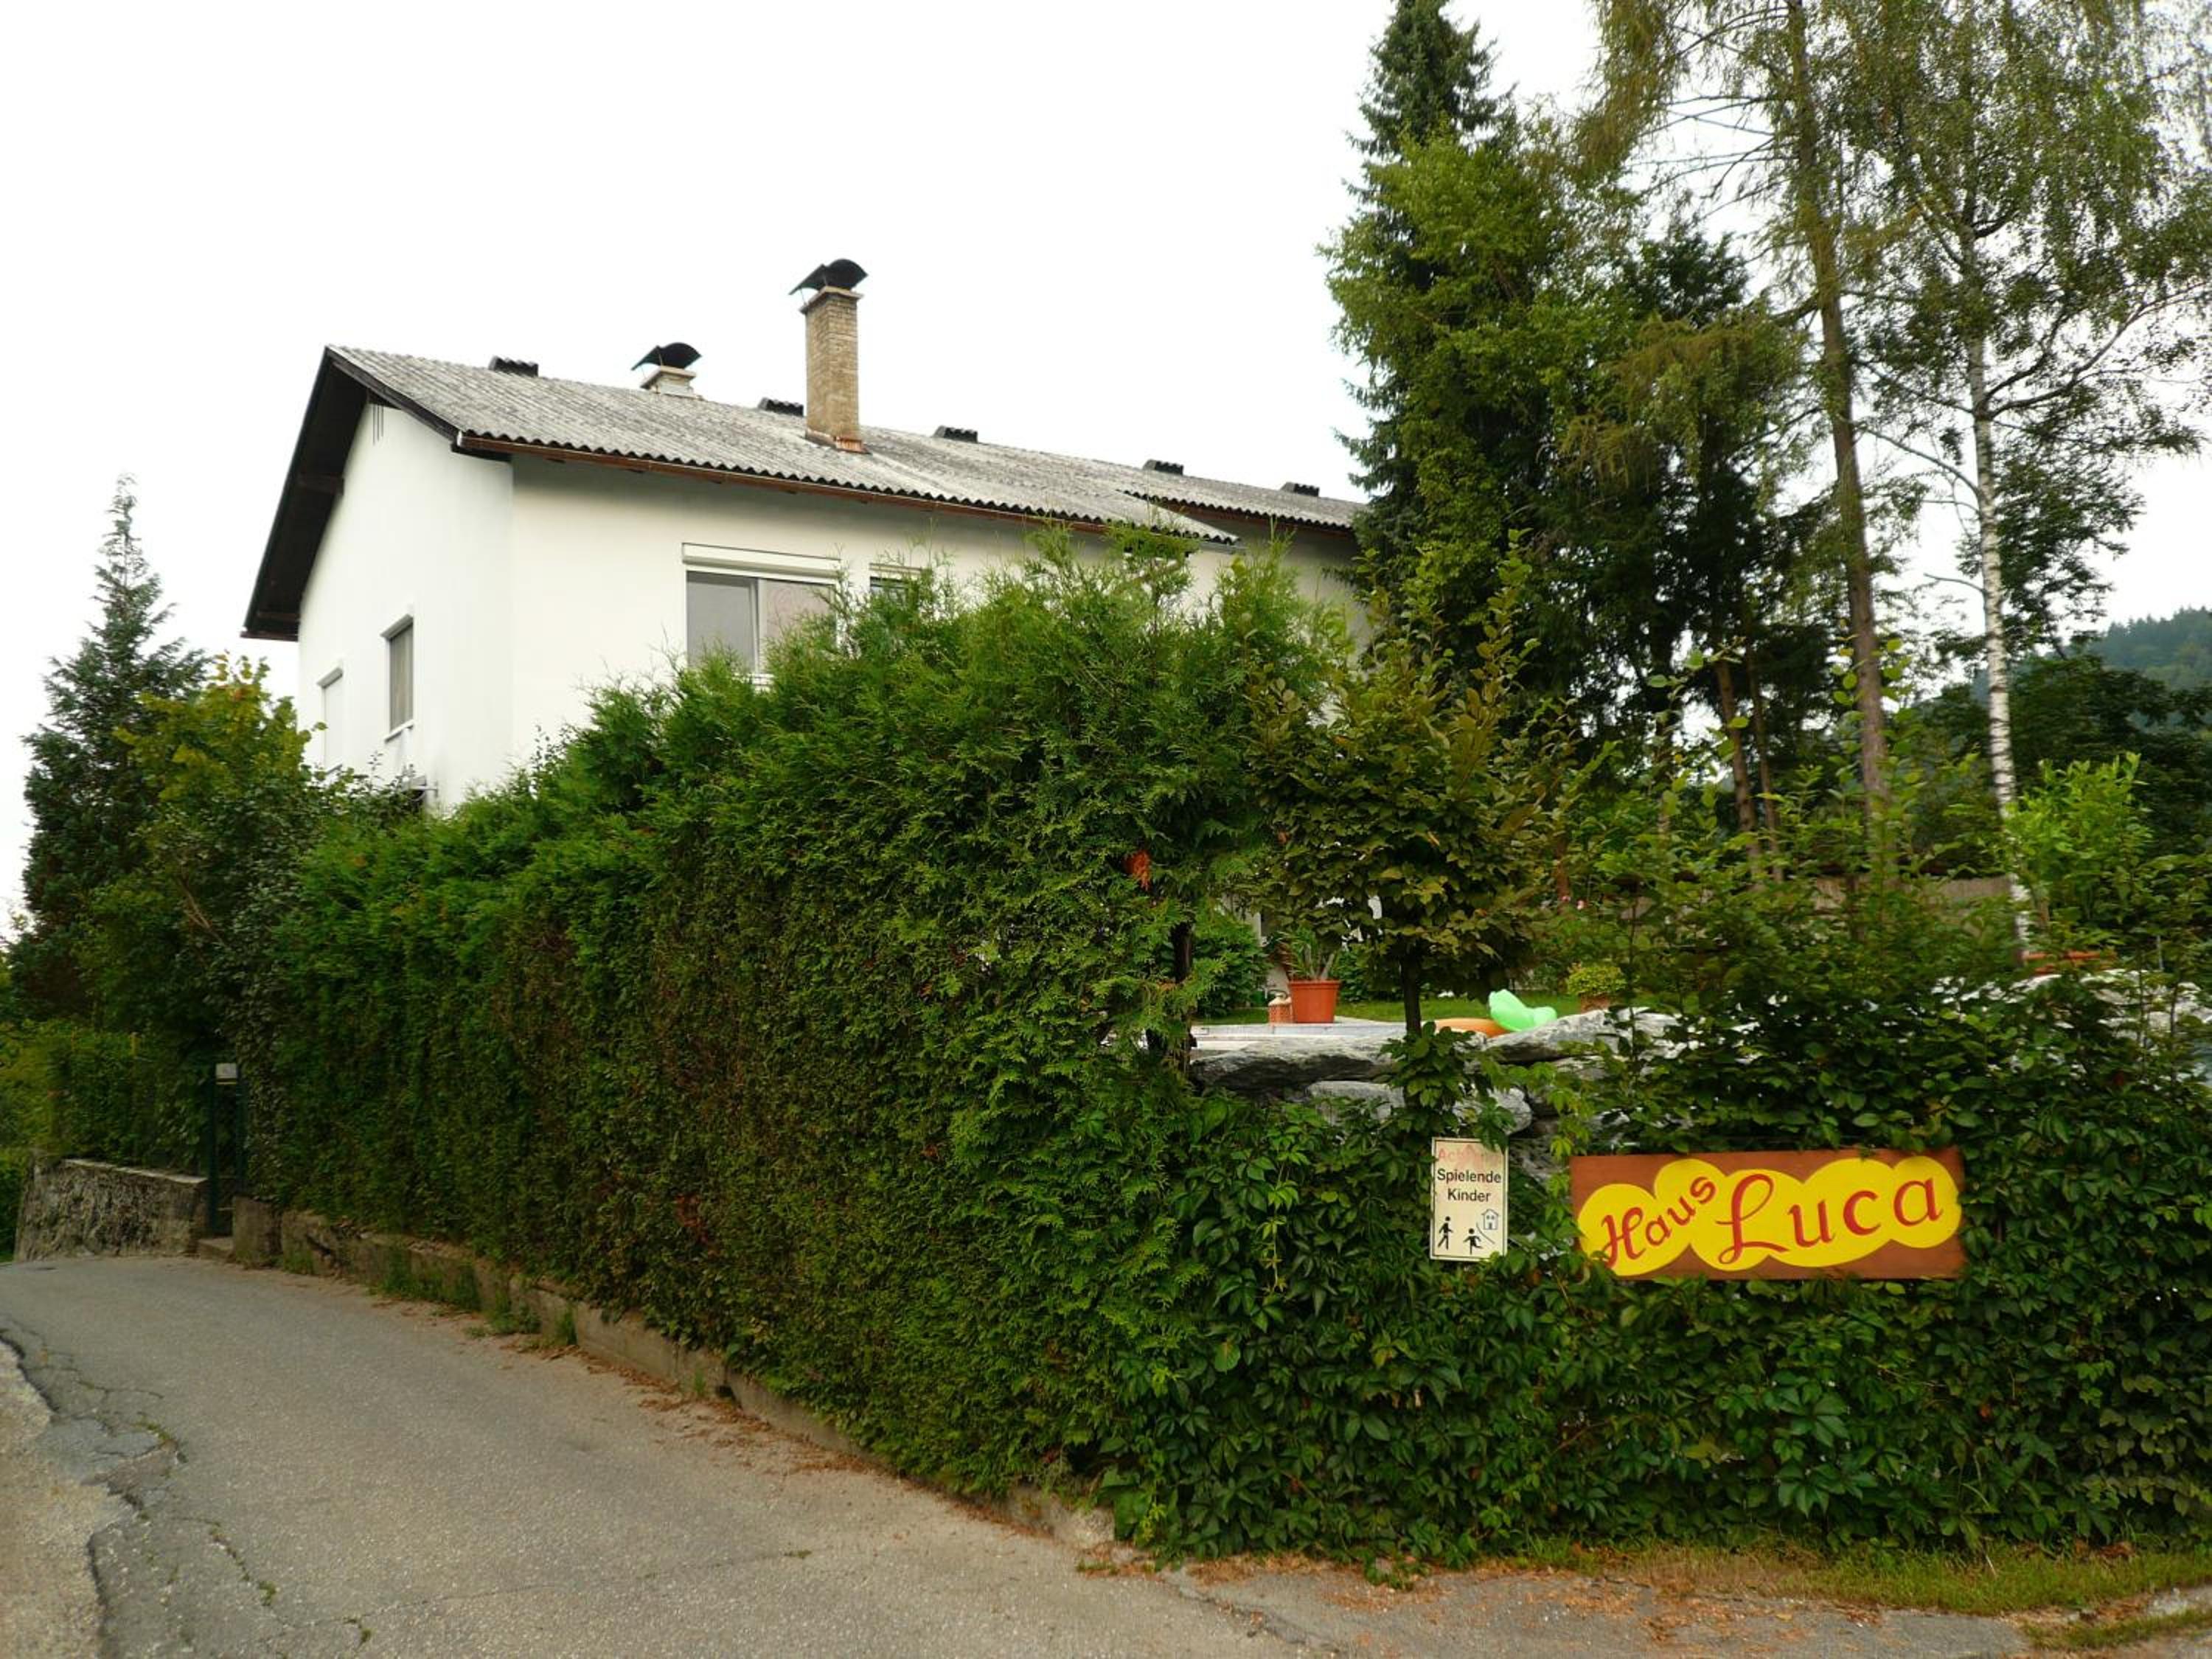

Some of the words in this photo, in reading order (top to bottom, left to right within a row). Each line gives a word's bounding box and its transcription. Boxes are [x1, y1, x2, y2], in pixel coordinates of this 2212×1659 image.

[1437, 1168, 1502, 1184] Spielende
[1447, 1188, 1492, 1203] Kinder
[1601, 1176, 1717, 1267] Haus
[1715, 1173, 1944, 1265] Luca
